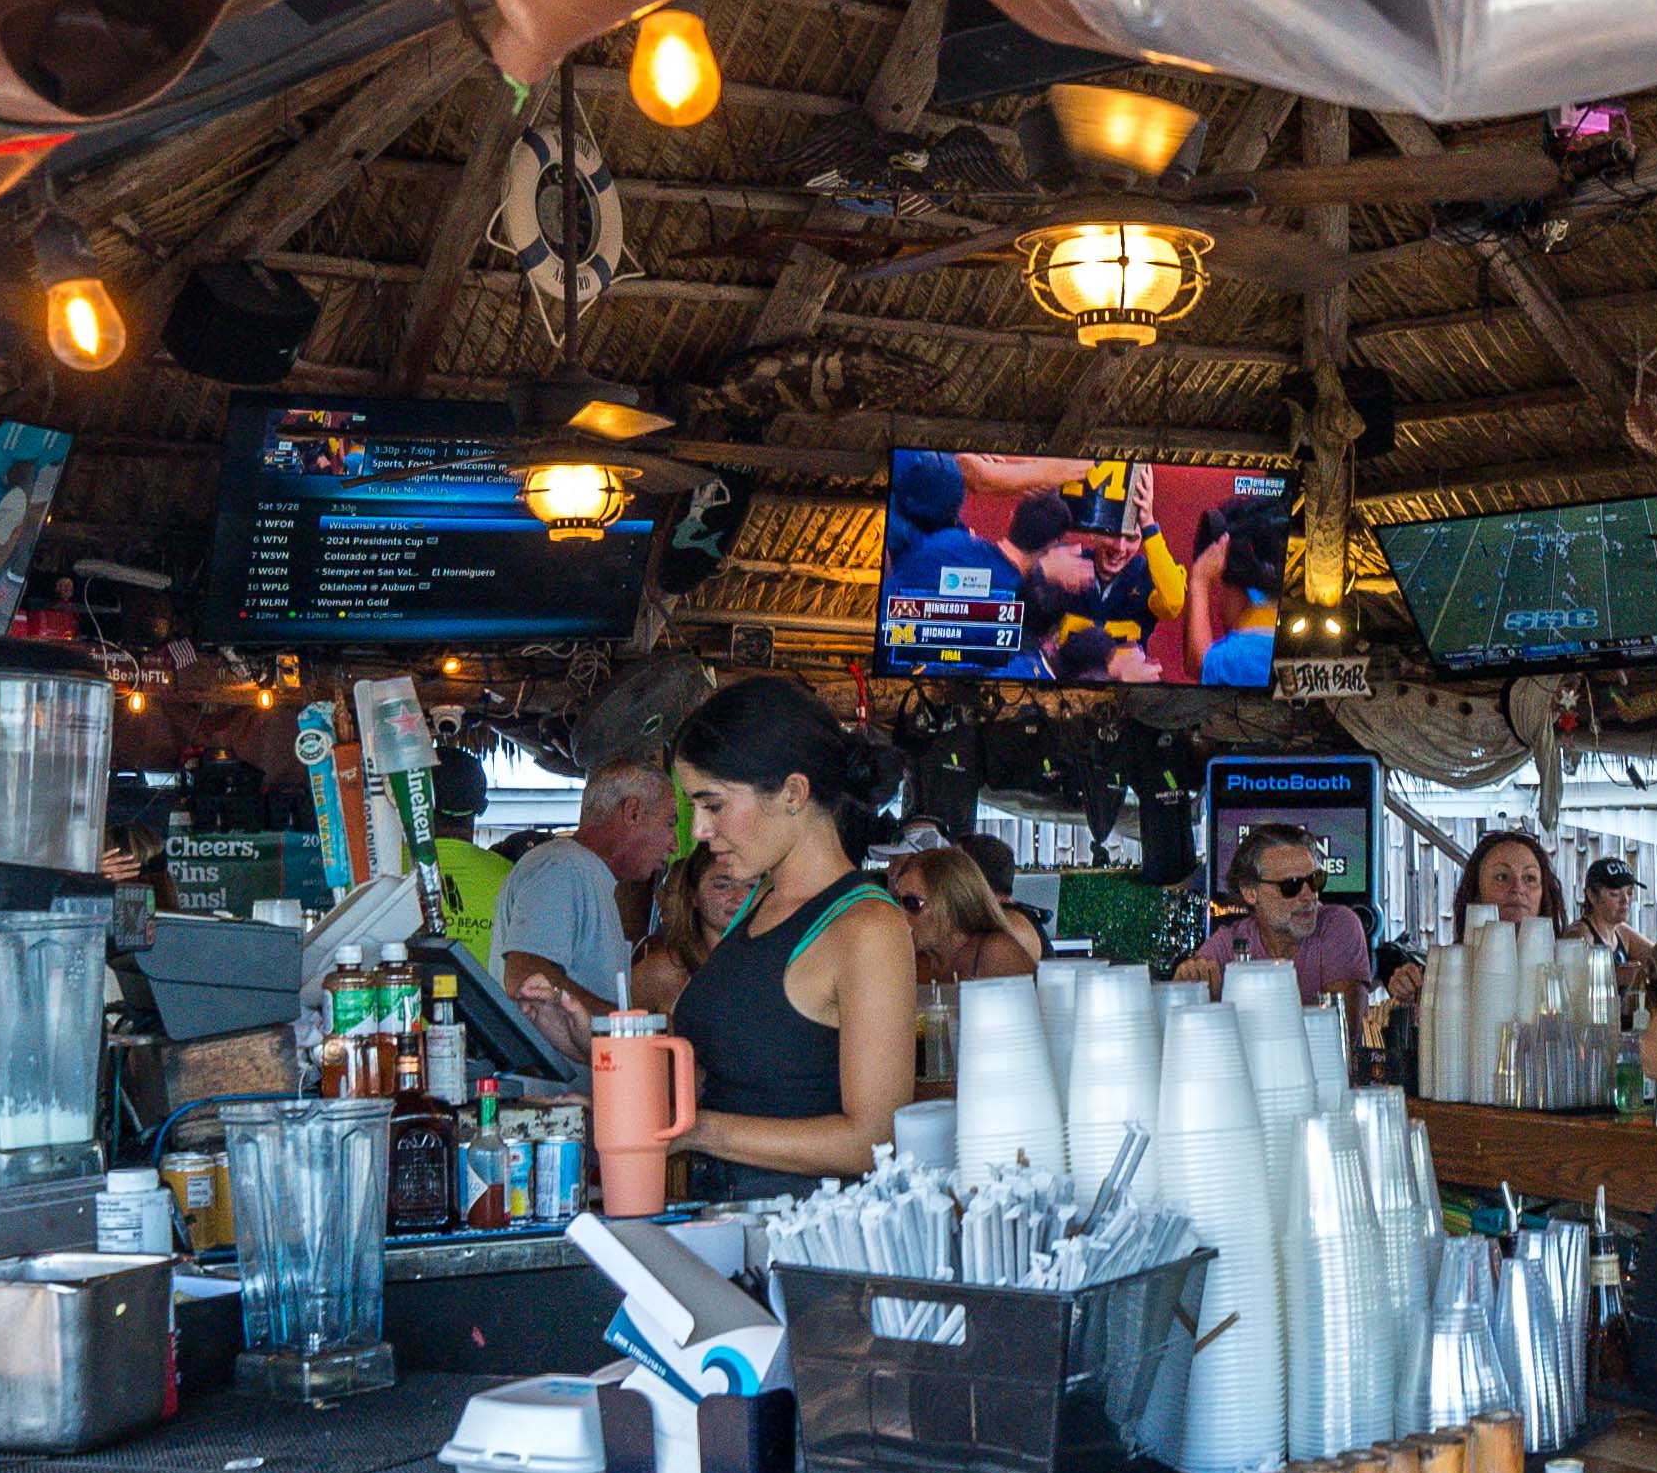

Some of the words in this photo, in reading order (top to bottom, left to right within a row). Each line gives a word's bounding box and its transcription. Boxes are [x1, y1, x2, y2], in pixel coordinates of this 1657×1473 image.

[371, 459, 404, 470] Sports,
[1234, 486, 1284, 497] SATURDAY
[258, 501, 275, 512] Sat
[326, 536, 351, 545] 2024
[352, 536, 403, 546] Presidents
[404, 536, 424, 547] Cup
[260, 551, 290, 560] WSVN
[323, 551, 367, 561] Colorado
[381, 551, 401, 561] UCF
[321, 567, 361, 578] Siempre
[362, 569, 375, 577] en
[377, 568, 395, 577] San
[442, 568, 496, 579] Hormiguero
[319, 582, 368, 592] Oklahoma
[380, 583, 416, 593] Auburn
[259, 598, 289, 608] WLRN
[316, 598, 353, 608] Woman
[354, 598, 364, 607] in
[366, 598, 390, 607] Gold
[923, 601, 969, 615] MINNESOTA
[998, 605, 1016, 622] 24
[921, 626, 963, 639] MICHIGAN
[995, 629, 1014, 646] 27
[940, 649, 962, 662] FINAL
[1227, 773, 1352, 791] PhotoBooth
[313, 773, 328, 807] BIG
[407, 766, 433, 844] eineken
[317, 808, 336, 869] WAVE
[165, 834, 261, 861] Cheers,
[167, 862, 220, 884] Fins
[176, 887, 228, 910] ans!
